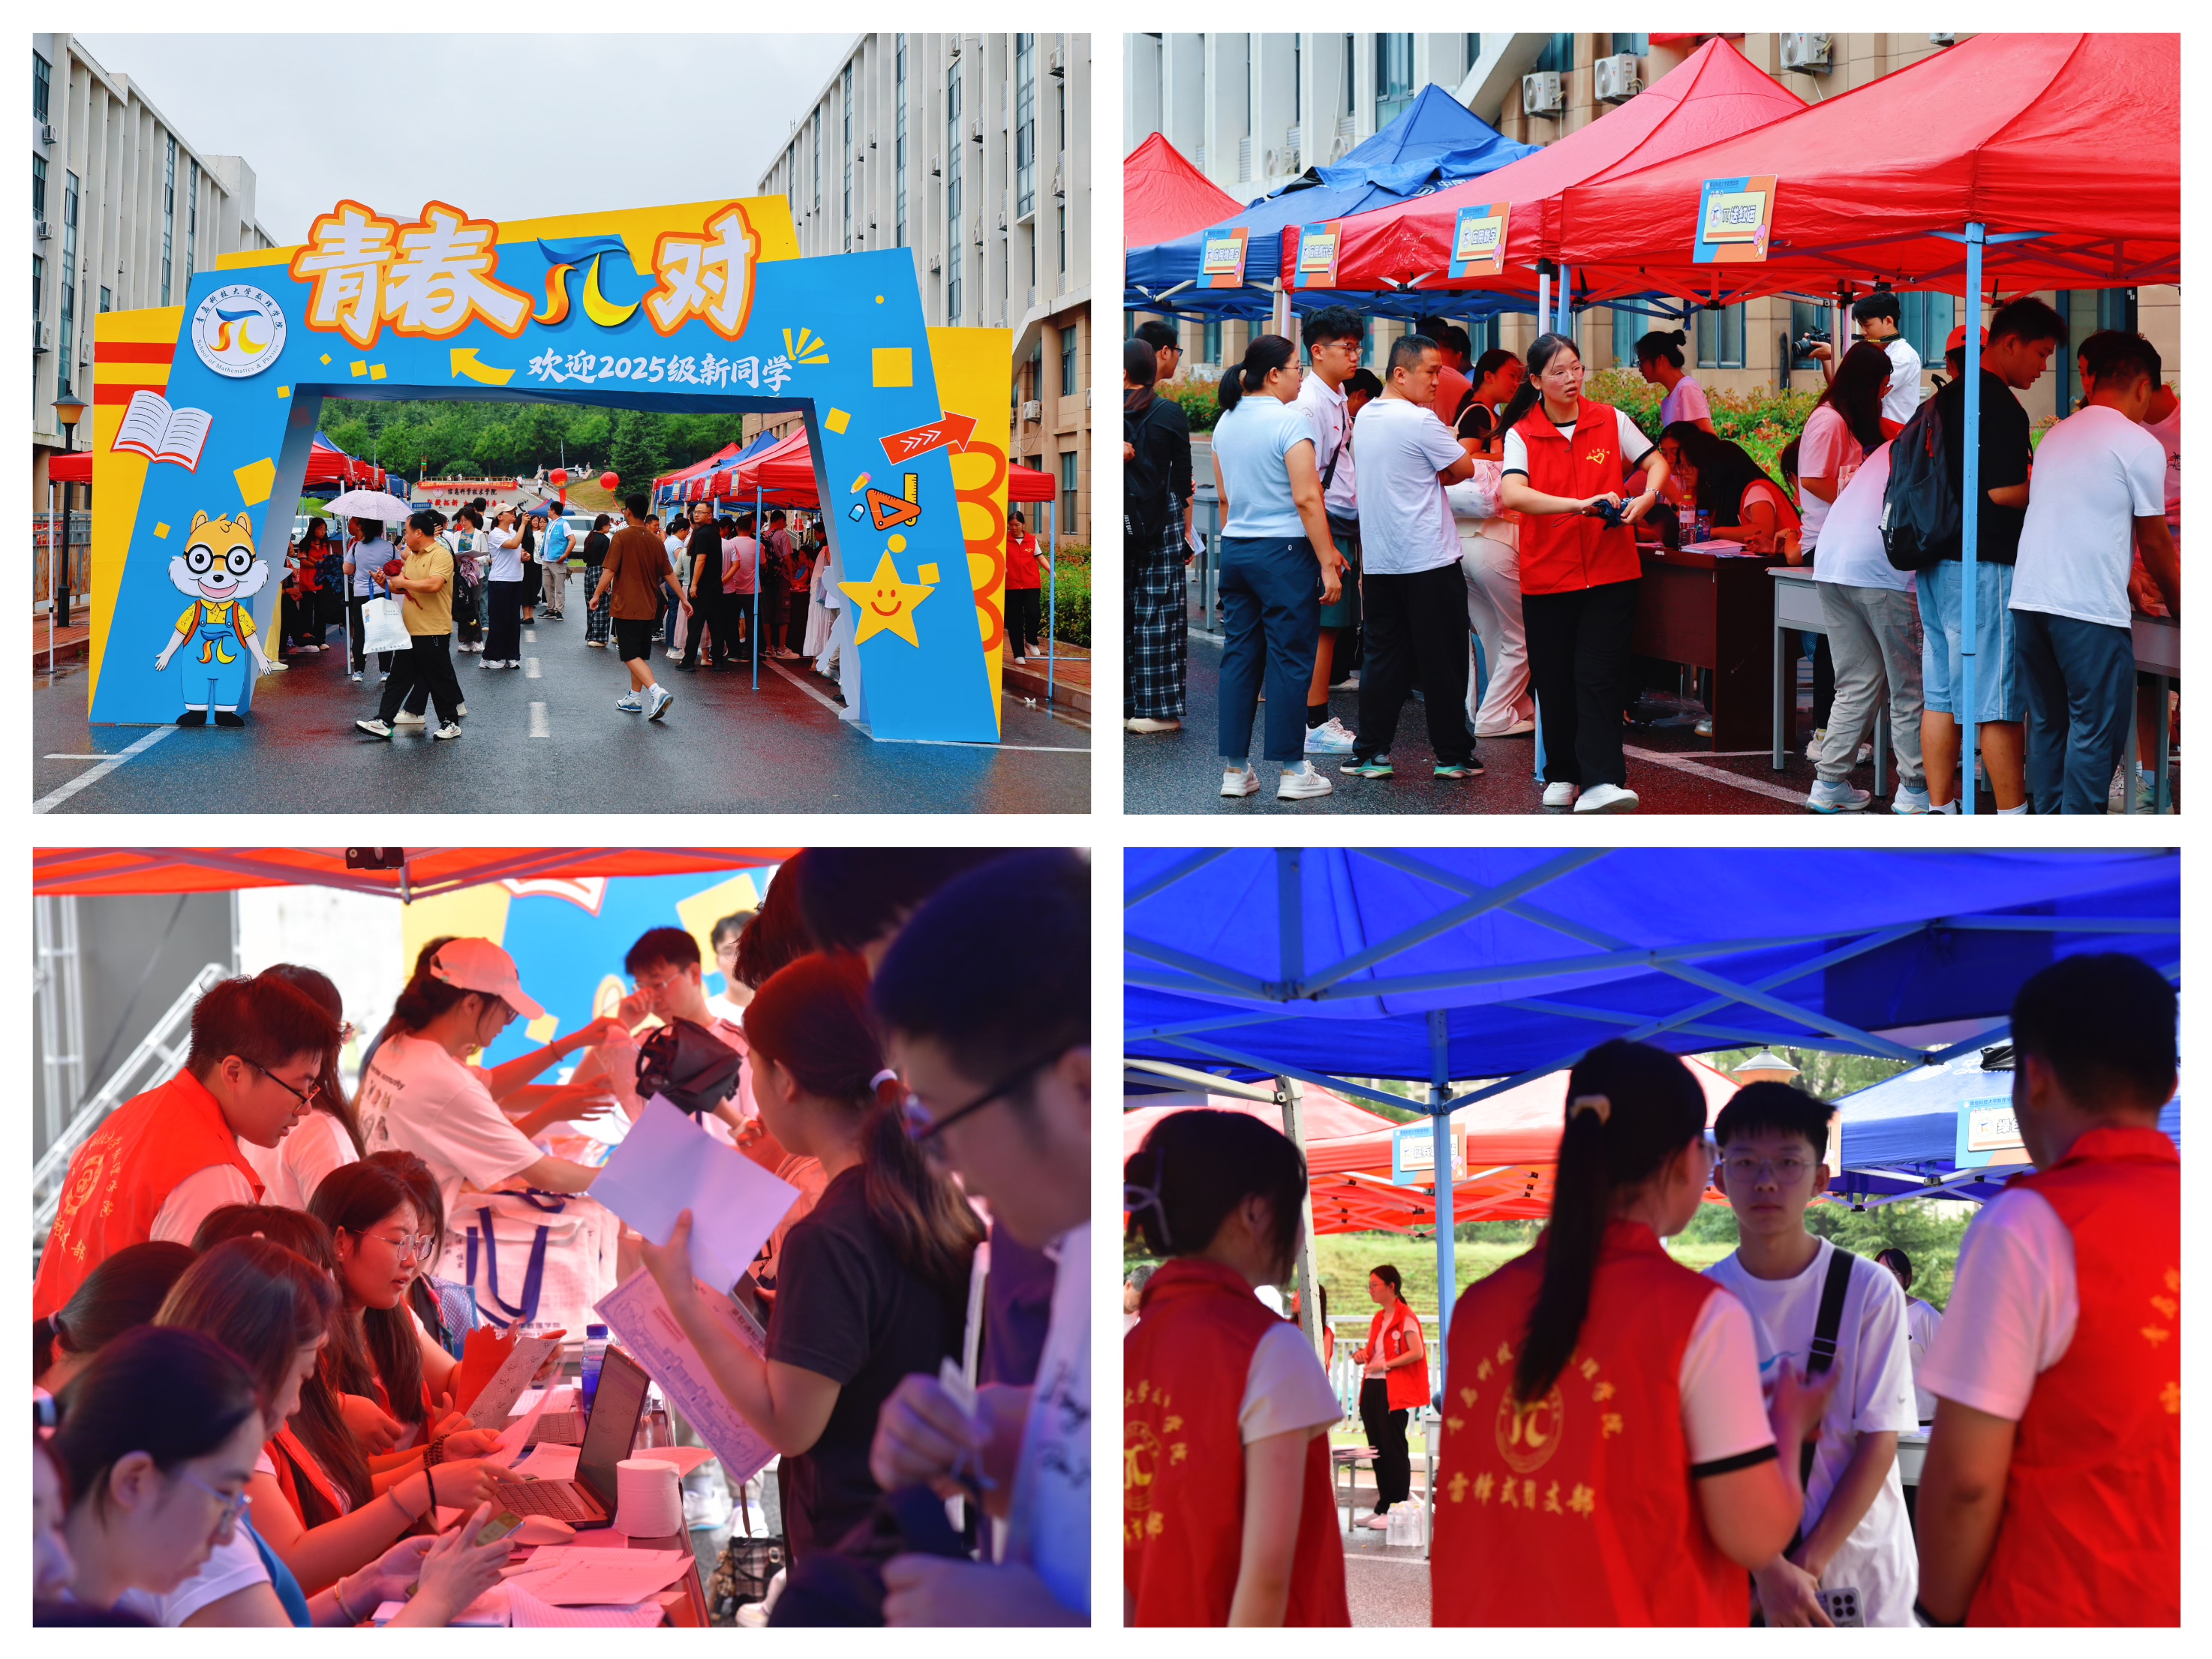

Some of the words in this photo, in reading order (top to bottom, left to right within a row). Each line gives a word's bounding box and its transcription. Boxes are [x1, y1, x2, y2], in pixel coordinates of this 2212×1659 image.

[1437, 179, 1470, 188] 中国
[197, 339, 209, 359] School
[215, 363, 254, 374] Mathematics
[262, 344, 280, 365] Physics
[527, 347, 793, 392] 欢迎2025级新同学
[448, 488, 497, 496] 信息科学技术学院
[1970, 1097, 2012, 1105] 青岛科技大学数理学
